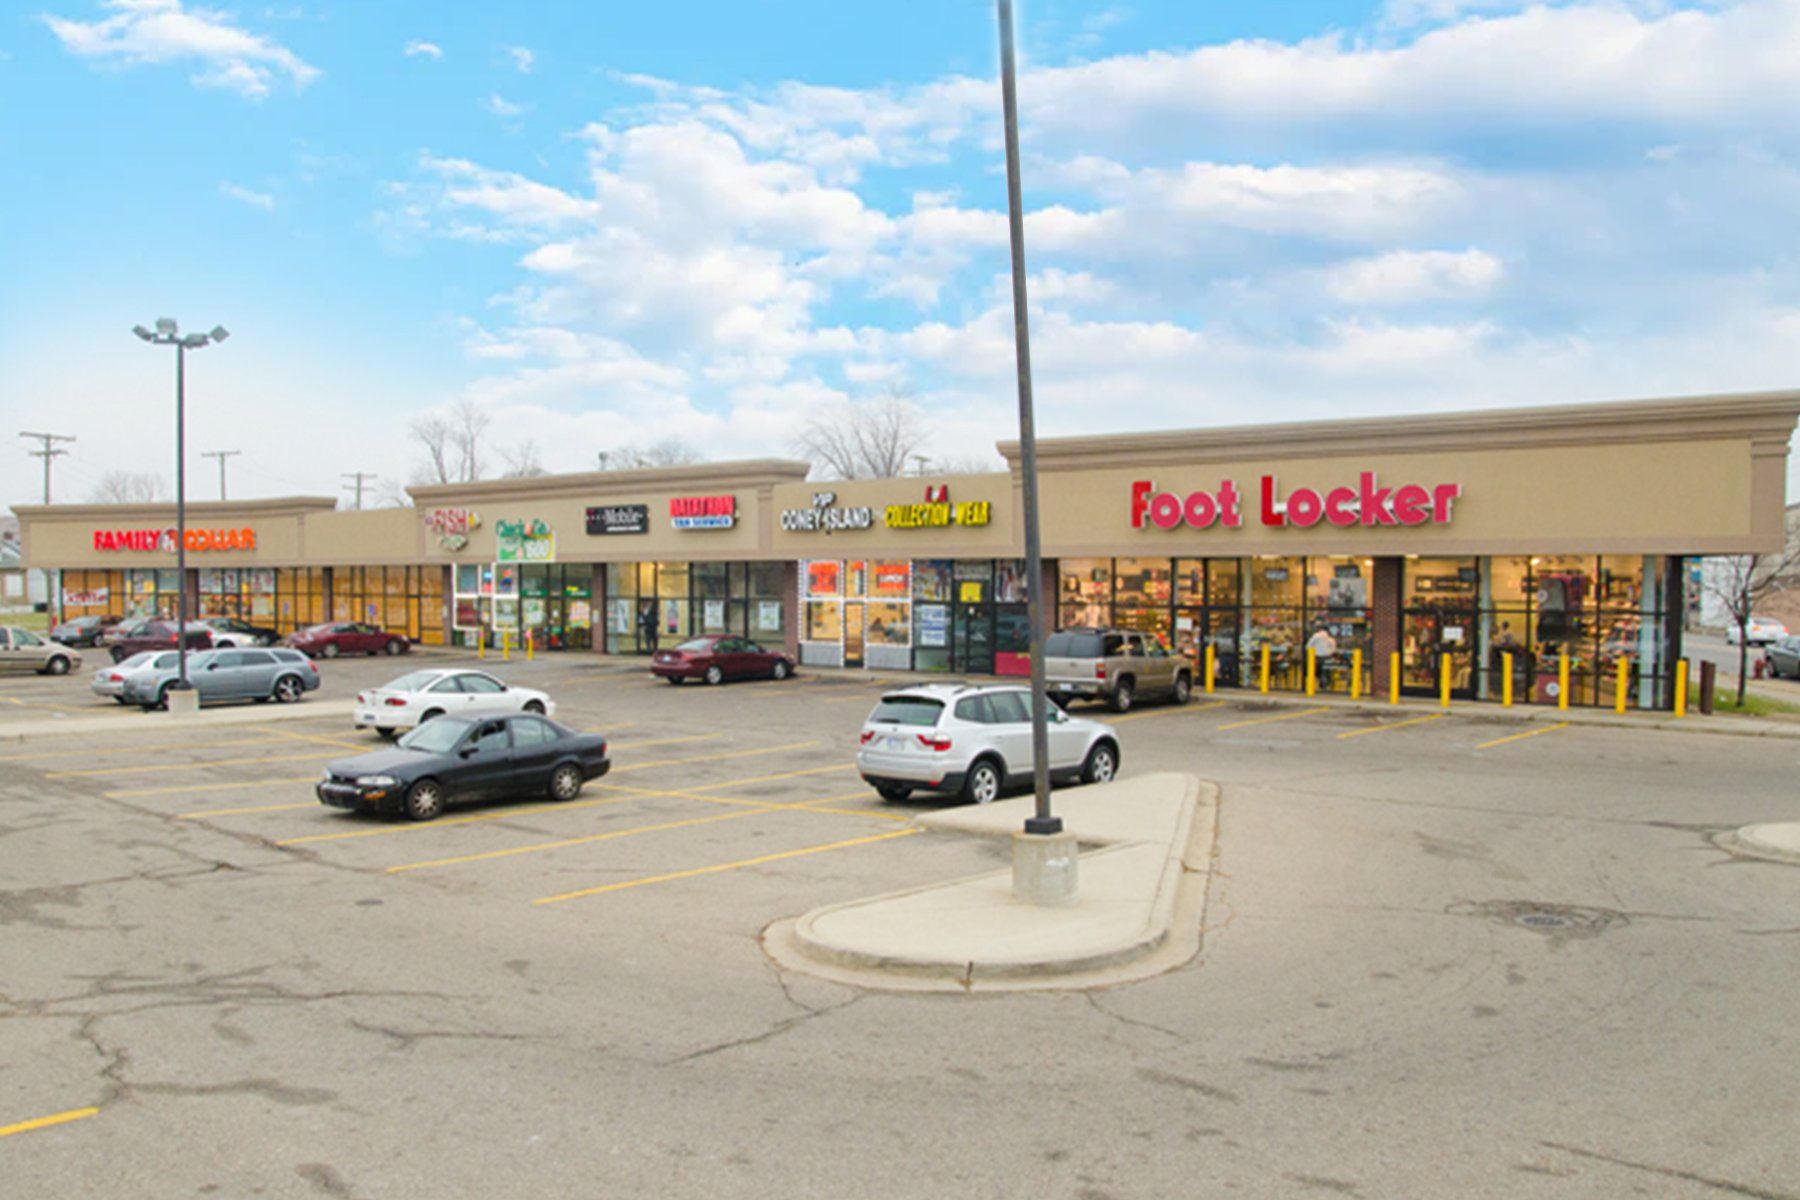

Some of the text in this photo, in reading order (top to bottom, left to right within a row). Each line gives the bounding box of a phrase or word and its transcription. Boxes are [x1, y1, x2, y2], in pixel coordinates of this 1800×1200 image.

[1131, 471, 1461, 529] Foot Locker
[780, 507, 873, 531] CONEY ISLAND
[884, 501, 989, 527] COLLECTION WEAR
[93, 529, 161, 551] FAMILY
